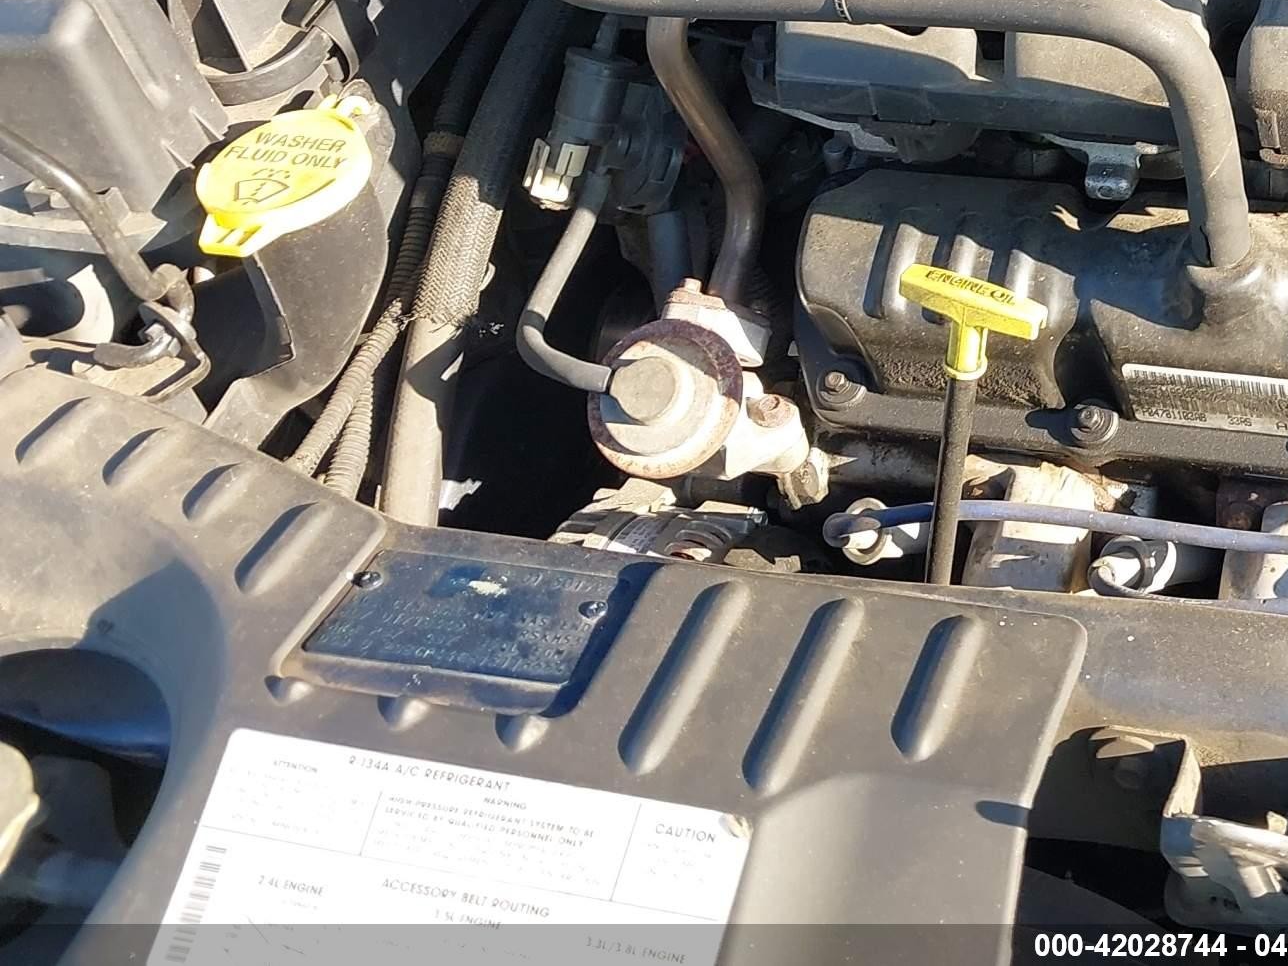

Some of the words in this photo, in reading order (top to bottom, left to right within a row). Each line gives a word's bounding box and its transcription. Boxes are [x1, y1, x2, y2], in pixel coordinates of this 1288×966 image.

[255, 131, 347, 153] WASHER
[223, 145, 289, 164] FLUID
[291, 151, 347, 170] ONLY
[925, 268, 987, 297] ENGINE
[990, 289, 1017, 306] OIL
[271, 758, 319, 774] ATTENTION
[394, 761, 420, 778] A/C
[423, 766, 512, 792] REFRIGERANT
[483, 796, 528, 811] WARNING
[654, 822, 716, 843] CAUTION
[557, 837, 584, 849] ONLY
[283, 880, 324, 897] ENGINE
[381, 878, 458, 902] ACCESSORY
[459, 891, 489, 908] BELT
[491, 898, 552, 919] ROUTING
[458, 914, 503, 931] ENGINE
[642, 946, 688, 965] ENGINE
